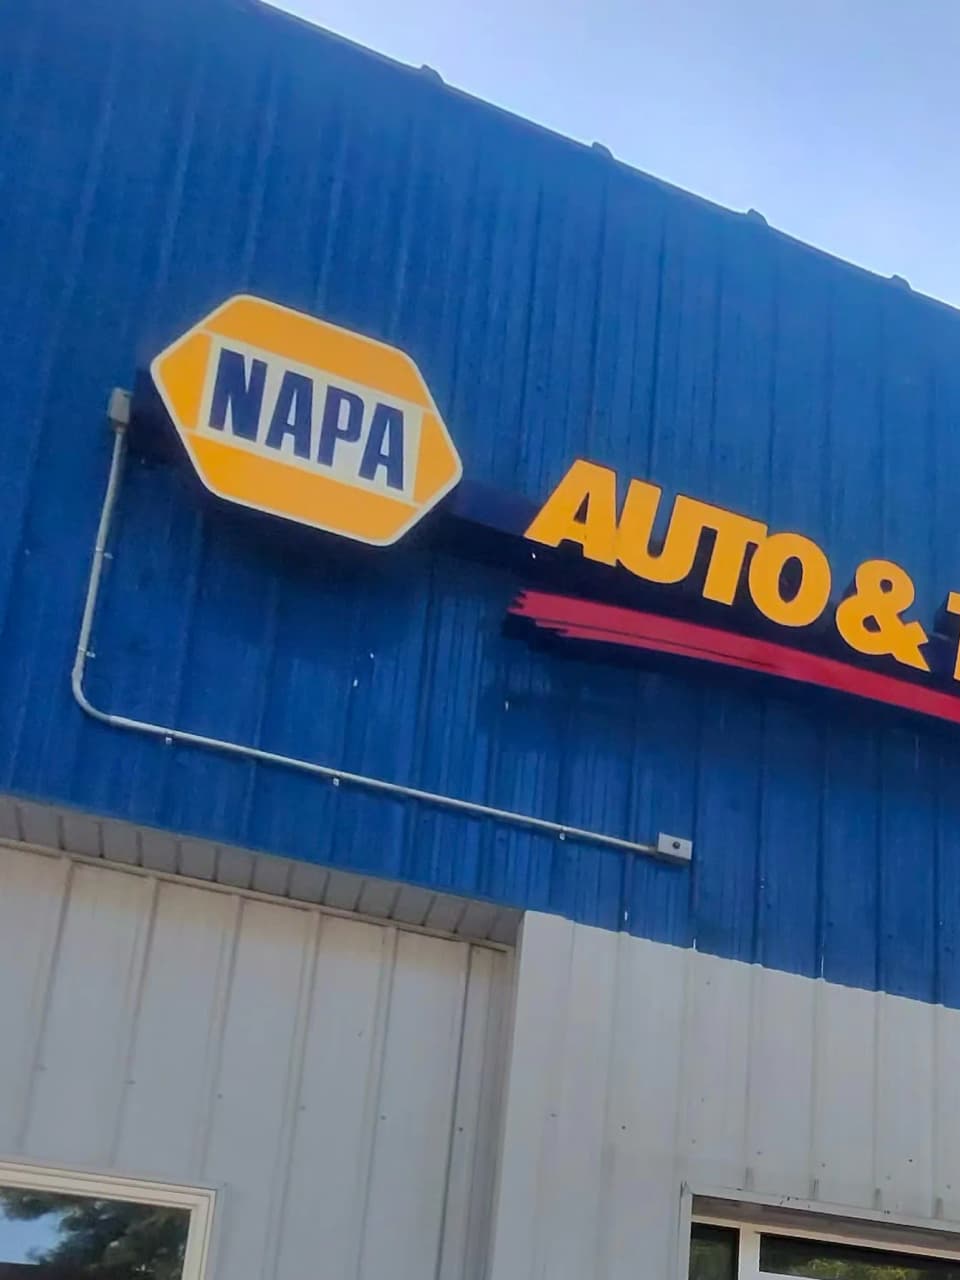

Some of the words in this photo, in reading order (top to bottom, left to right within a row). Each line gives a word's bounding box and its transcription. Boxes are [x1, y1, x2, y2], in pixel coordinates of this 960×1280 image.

[208, 347, 405, 492] NAPA
[524, 458, 832, 627] AUTO
[836, 559, 931, 673] &
